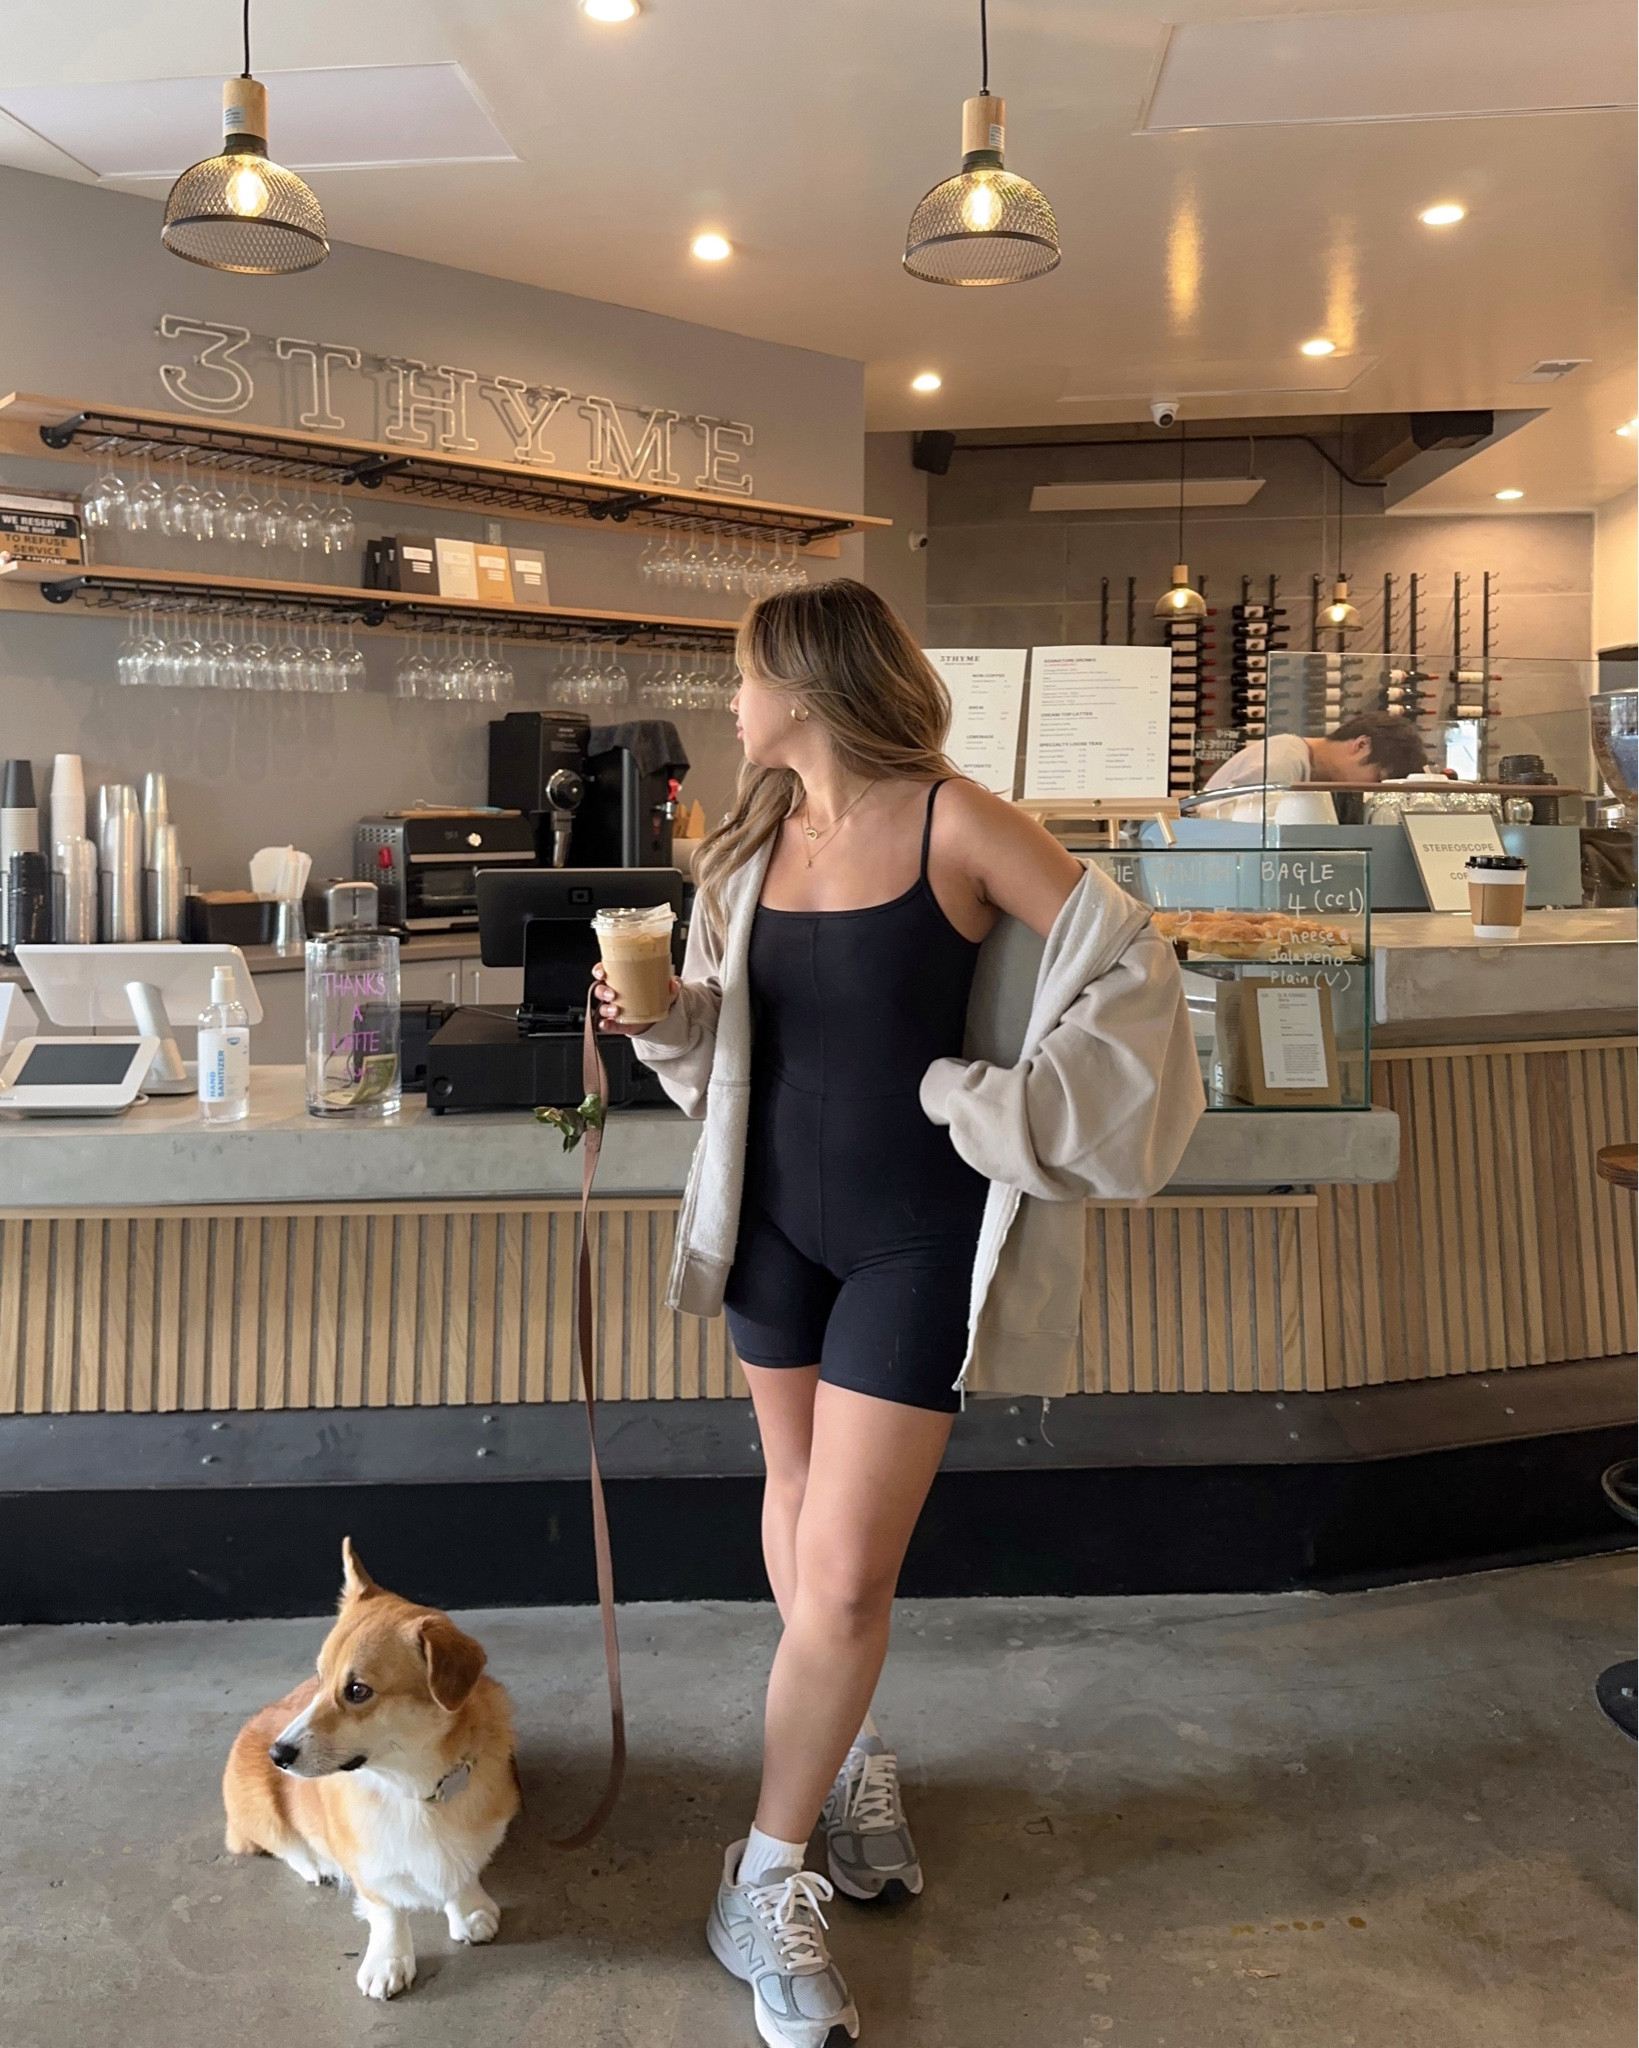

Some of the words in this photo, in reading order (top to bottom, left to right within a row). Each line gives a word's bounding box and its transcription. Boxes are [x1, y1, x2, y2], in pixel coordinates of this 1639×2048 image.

[159, 313, 754, 496] 3THYME
[1, 515, 19, 524] WE
[21, 517, 68, 530] RESERVE
[4, 533, 21, 543] TO
[24, 535, 68, 547] REFUSE
[13, 544, 61, 555] SERVICE
[1422, 843, 1495, 853] STEREOSCOPE
[1261, 860, 1335, 886] BAGLE
[1449, 872, 1469, 881] COF
[1288, 892, 1307, 919] 4
[1277, 927, 1335, 946] Cheese
[320, 971, 386, 998] THANKS
[1270, 970, 1310, 985] Plain
[1314, 969, 1352, 992] (V)
[352, 1003, 364, 1022] A
[331, 1030, 380, 1052] LATTE
[217, 1050, 225, 1098] SANITIZER
